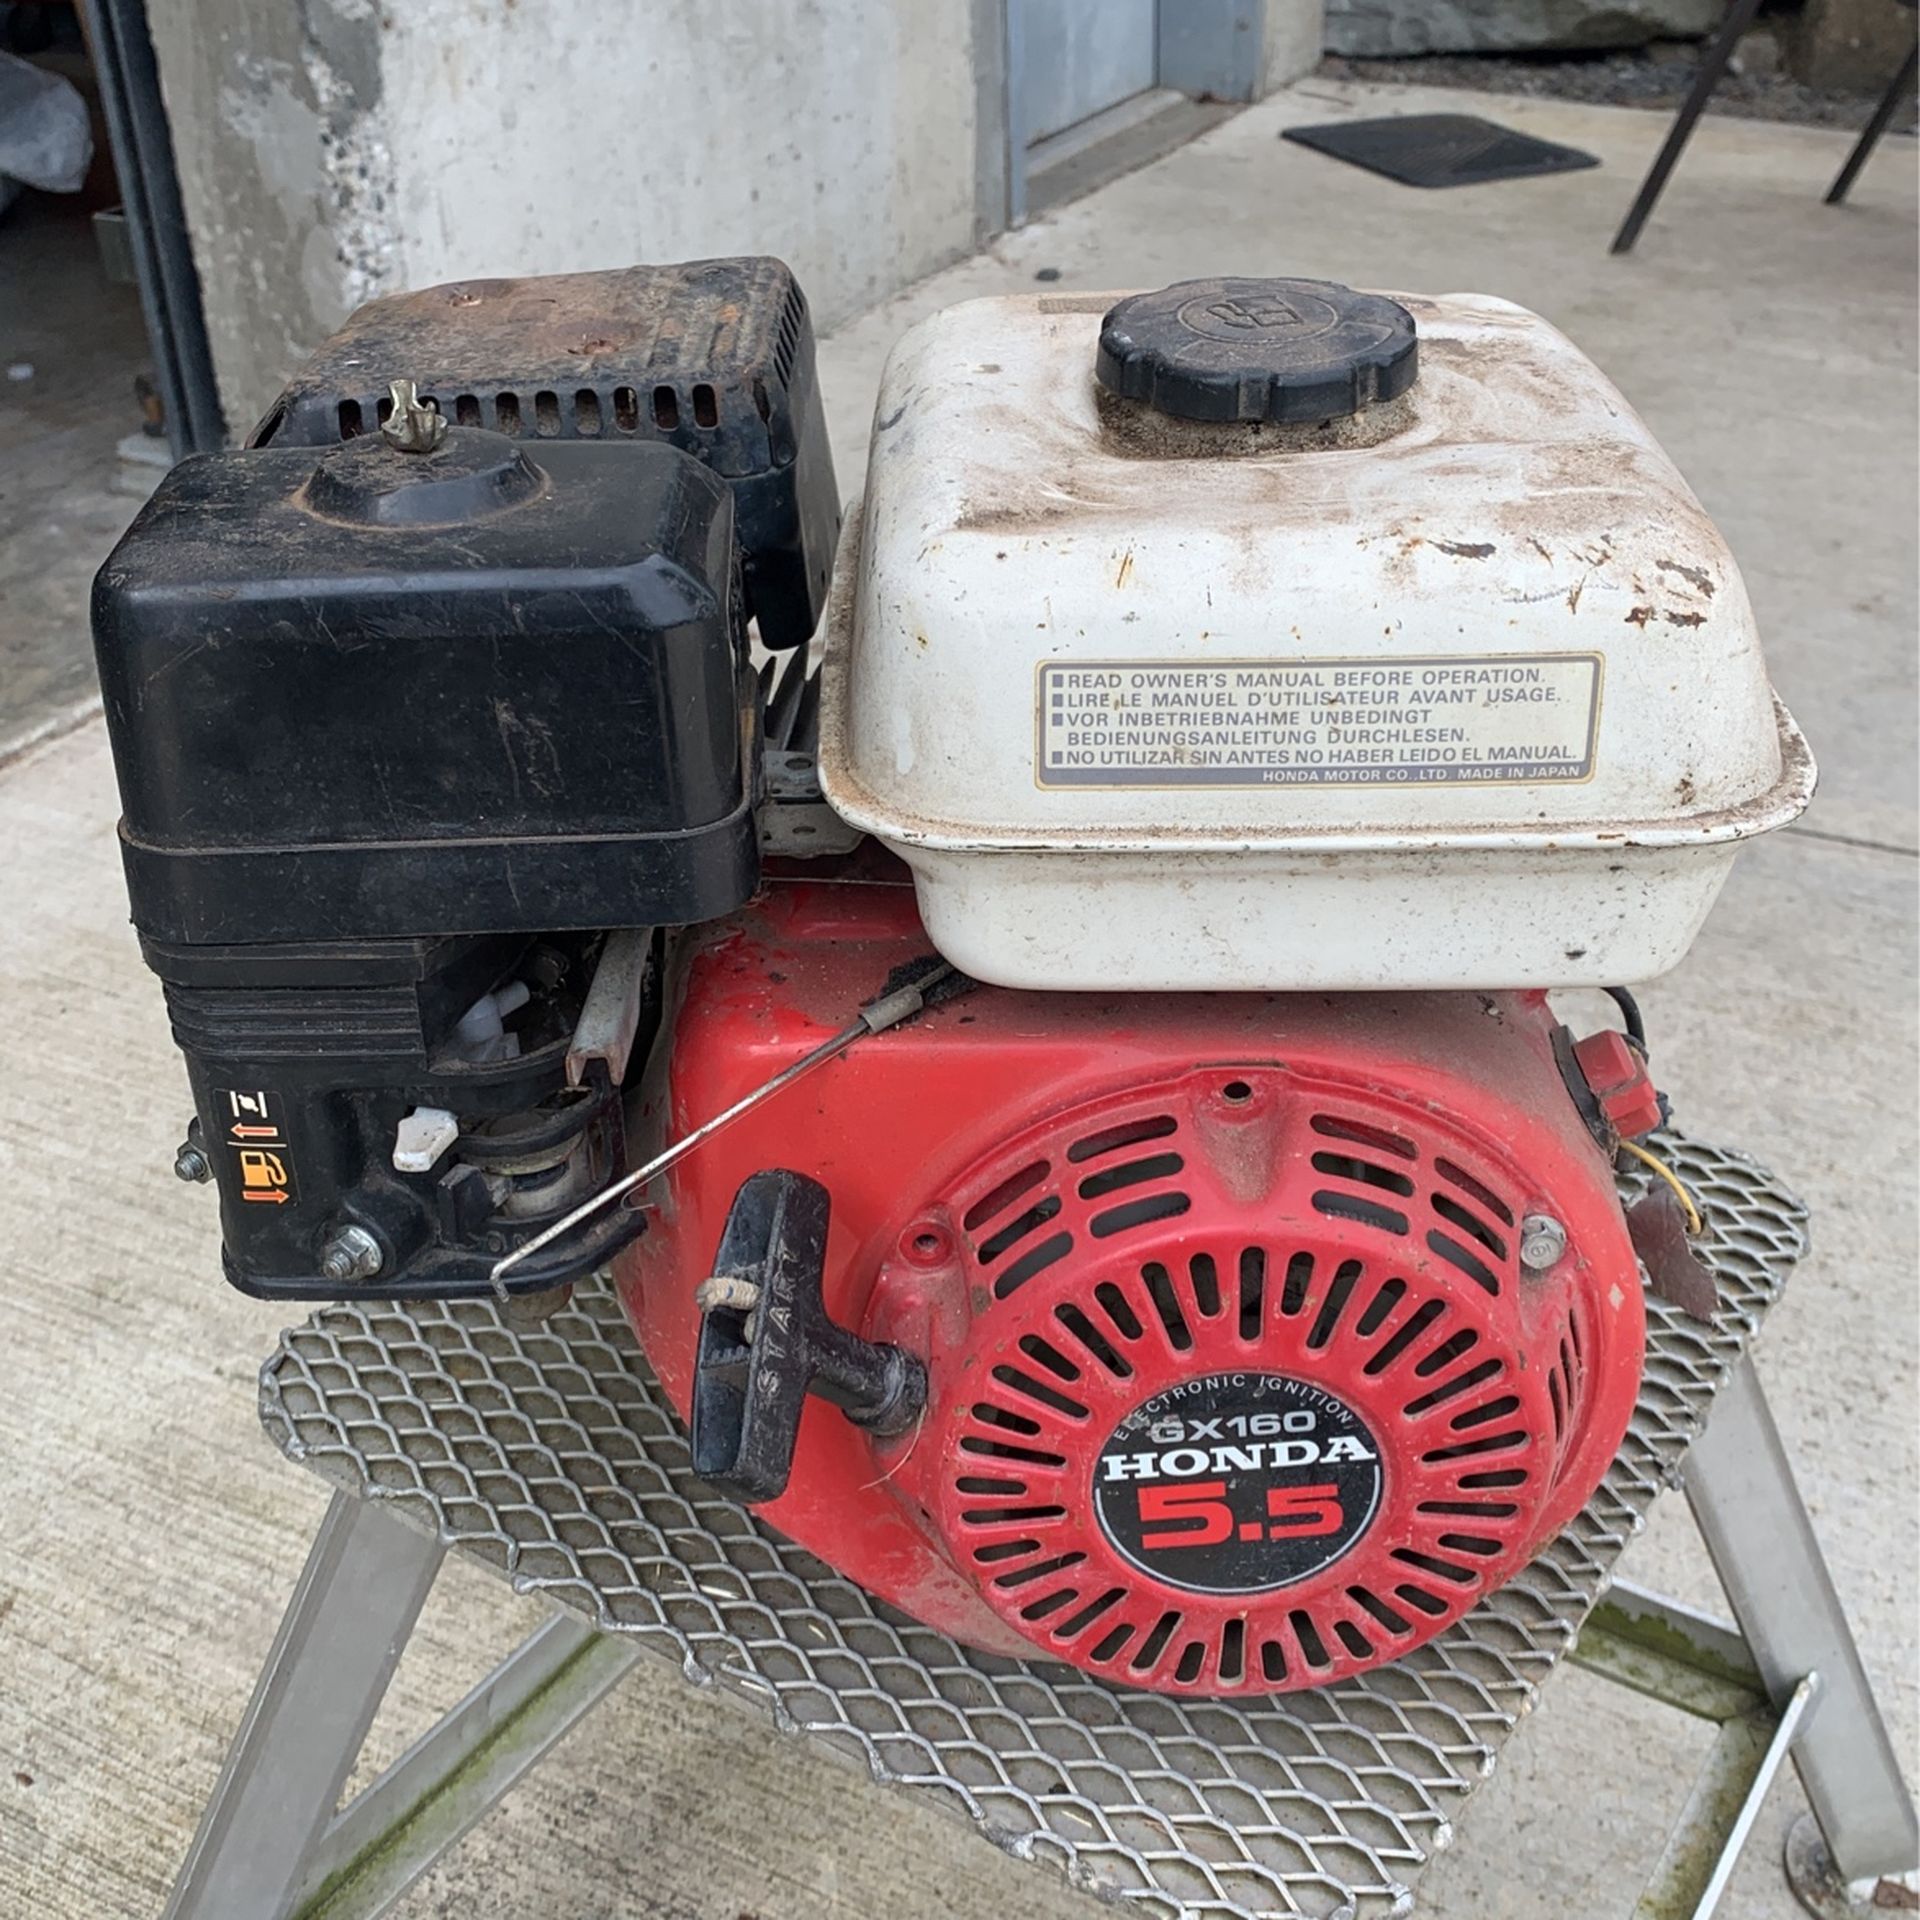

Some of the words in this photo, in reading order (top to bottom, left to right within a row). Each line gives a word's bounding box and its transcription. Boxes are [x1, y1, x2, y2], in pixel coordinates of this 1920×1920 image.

[1068, 673, 1122, 688] READ
[1131, 673, 1227, 688] OWNER'S
[1236, 672, 1325, 688] MANUAL
[1334, 671, 1413, 686] BEFORE
[1422, 668, 1546, 685] OPERATION.
[1068, 693, 1110, 707] LIRE
[1120, 693, 1142, 707] LE
[1151, 692, 1238, 707] MANUEL
[1248, 690, 1399, 706] D'UTILISATEUR
[1408, 689, 1477, 704] AVANT
[1487, 687, 1561, 703] USAGE.
[1066, 712, 1108, 727] VOR
[1119, 711, 1300, 726] INBETRIEBNAHME
[1310, 709, 1432, 725] UNBEDINGT
[1068, 730, 1317, 746] BEDIENUNGSANLEITUNG
[1328, 728, 1470, 744] DURCHLESEN.
[1066, 751, 1095, 765] NO
[1101, 750, 1184, 765] UTILIZAR
[1190, 750, 1222, 764] SIN
[1226, 750, 1290, 764] ANTES
[1295, 749, 1324, 764] NO
[1328, 749, 1394, 763] HABER
[1400, 747, 1456, 762] LEIDO
[1462, 747, 1483, 761] EL
[1487, 745, 1577, 761] MANUAL.
[1263, 770, 1319, 782] HONDA
[1324, 769, 1380, 781] MOTOR
[1457, 767, 1502, 779] MADE
[1508, 767, 1524, 778] IN
[1528, 765, 1580, 778] JAPAN
[1114, 1374, 1247, 1442] ELECTRONIC
[1259, 1375, 1353, 1424] IGNITION
[1150, 1410, 1316, 1444] GX160
[1102, 1435, 1377, 1481] HONDA
[1137, 1481, 1344, 1550] 5.5
